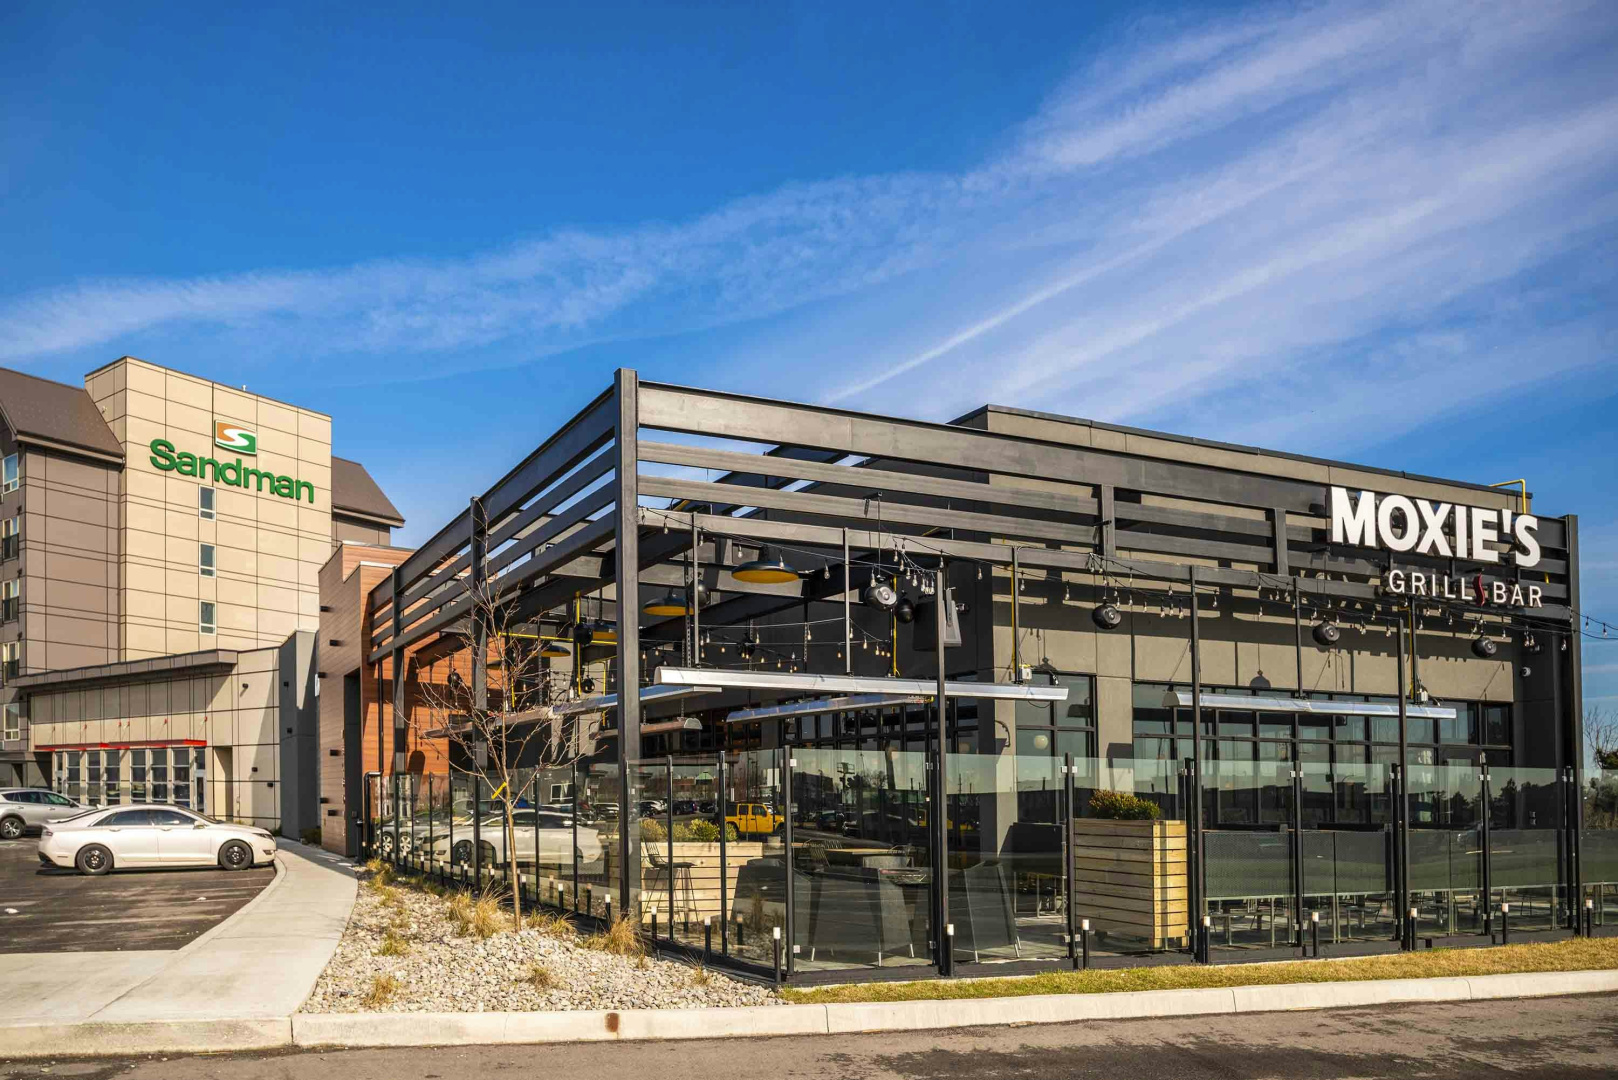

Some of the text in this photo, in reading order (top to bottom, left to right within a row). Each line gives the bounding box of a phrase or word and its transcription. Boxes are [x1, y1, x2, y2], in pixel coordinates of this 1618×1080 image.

[149, 438, 315, 504] Sandman
[1330, 486, 1542, 568] MOXIE'S
[1388, 570, 1543, 608] GRILL BAR
